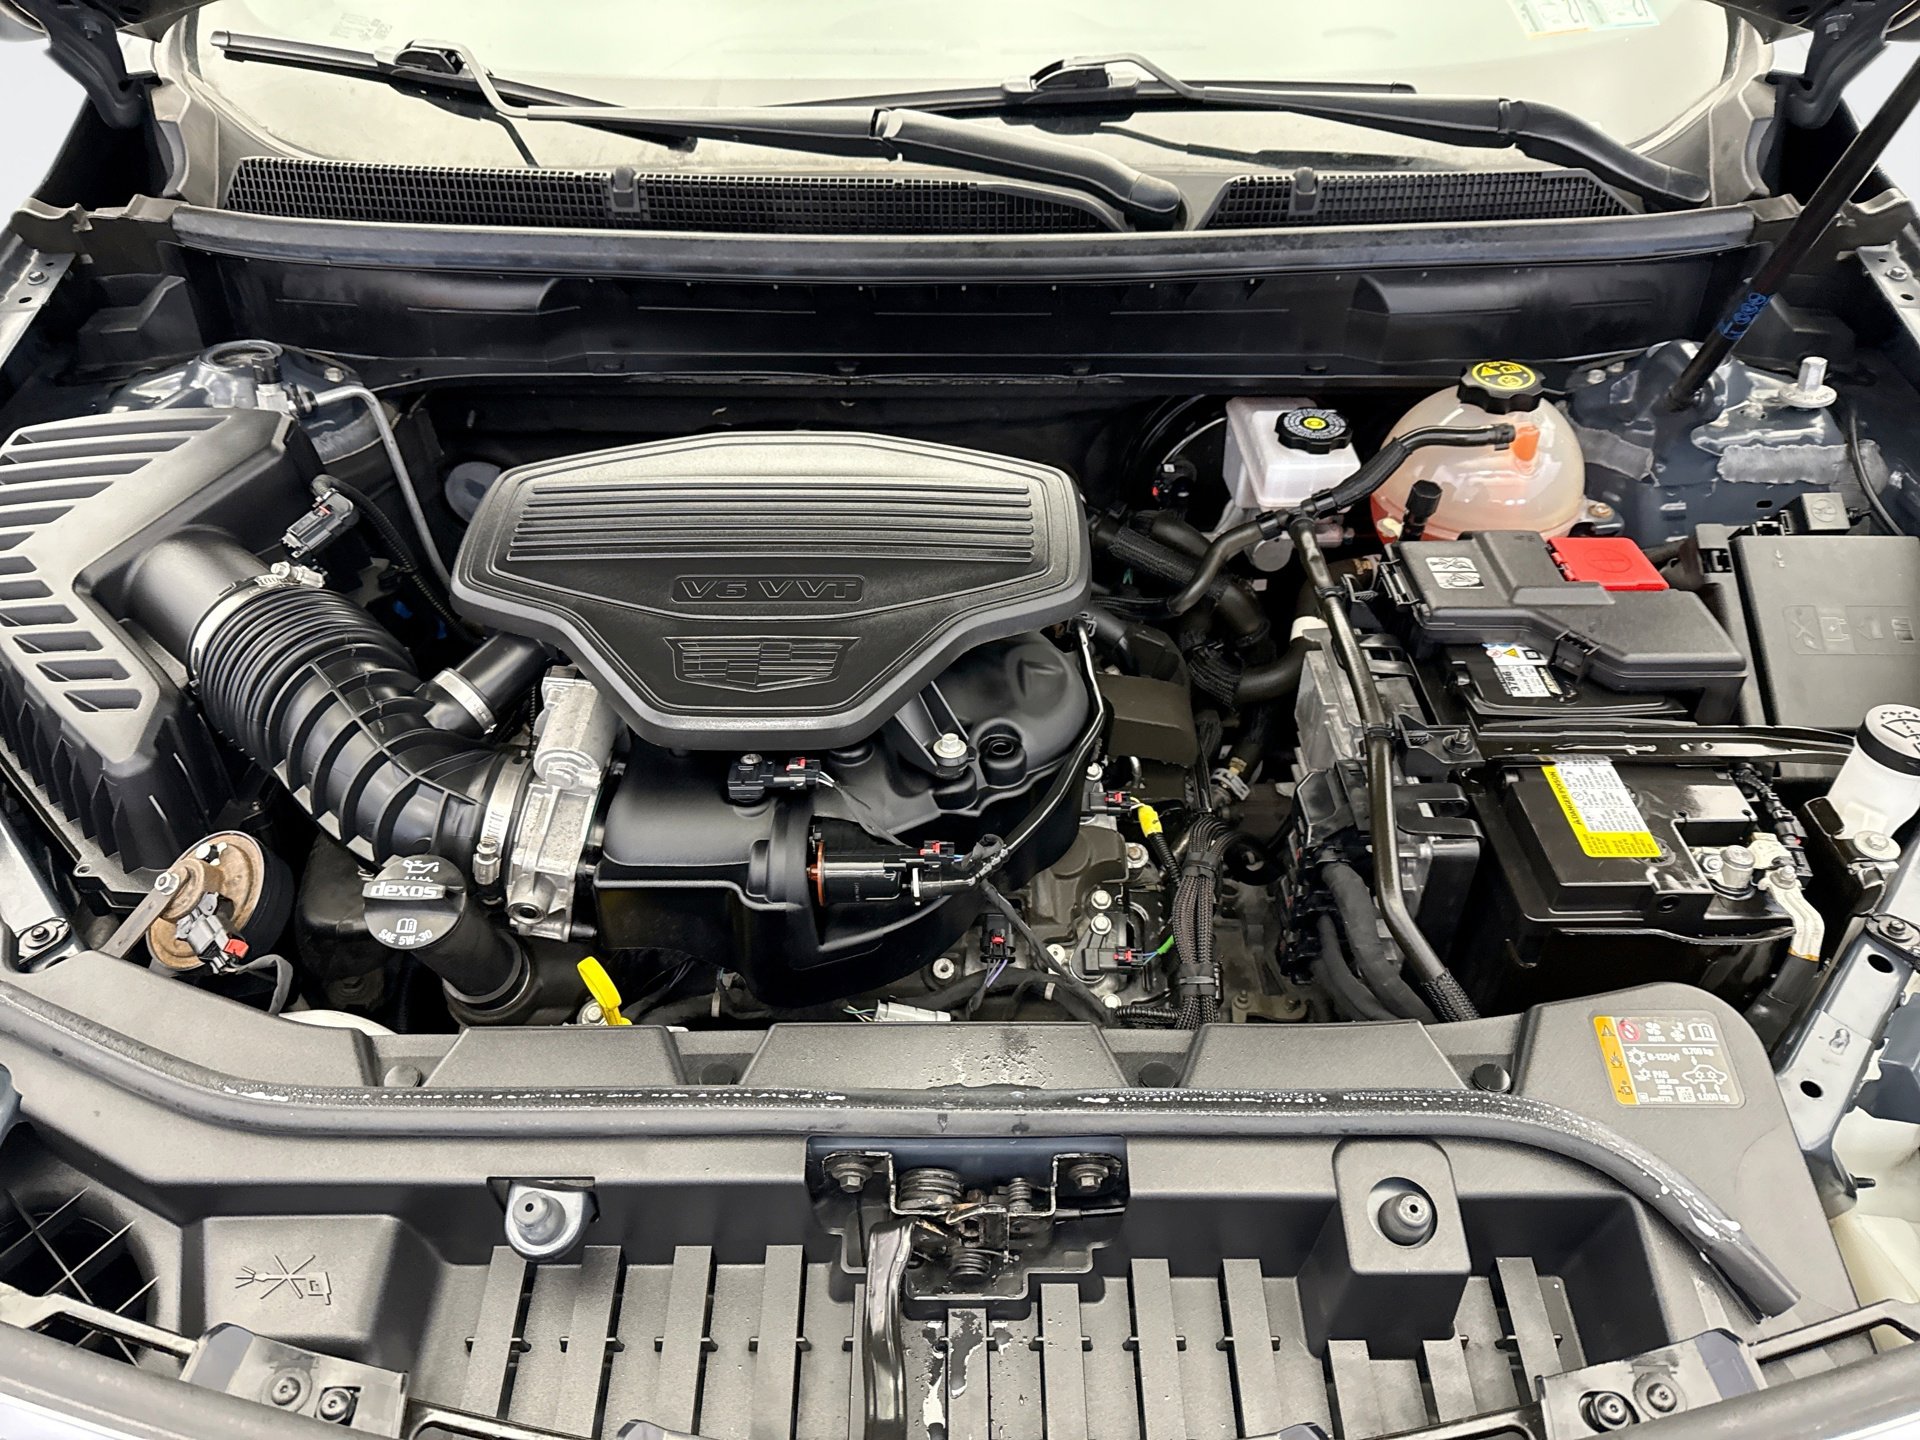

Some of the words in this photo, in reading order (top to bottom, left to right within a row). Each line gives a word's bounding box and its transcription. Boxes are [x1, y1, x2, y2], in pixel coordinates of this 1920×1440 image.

[681, 580, 748, 599] V6
[758, 580, 857, 599] VVT
[371, 882, 437, 898] dexos
[378, 929, 398, 944] SAE
[398, 929, 433, 946] 5W-30
